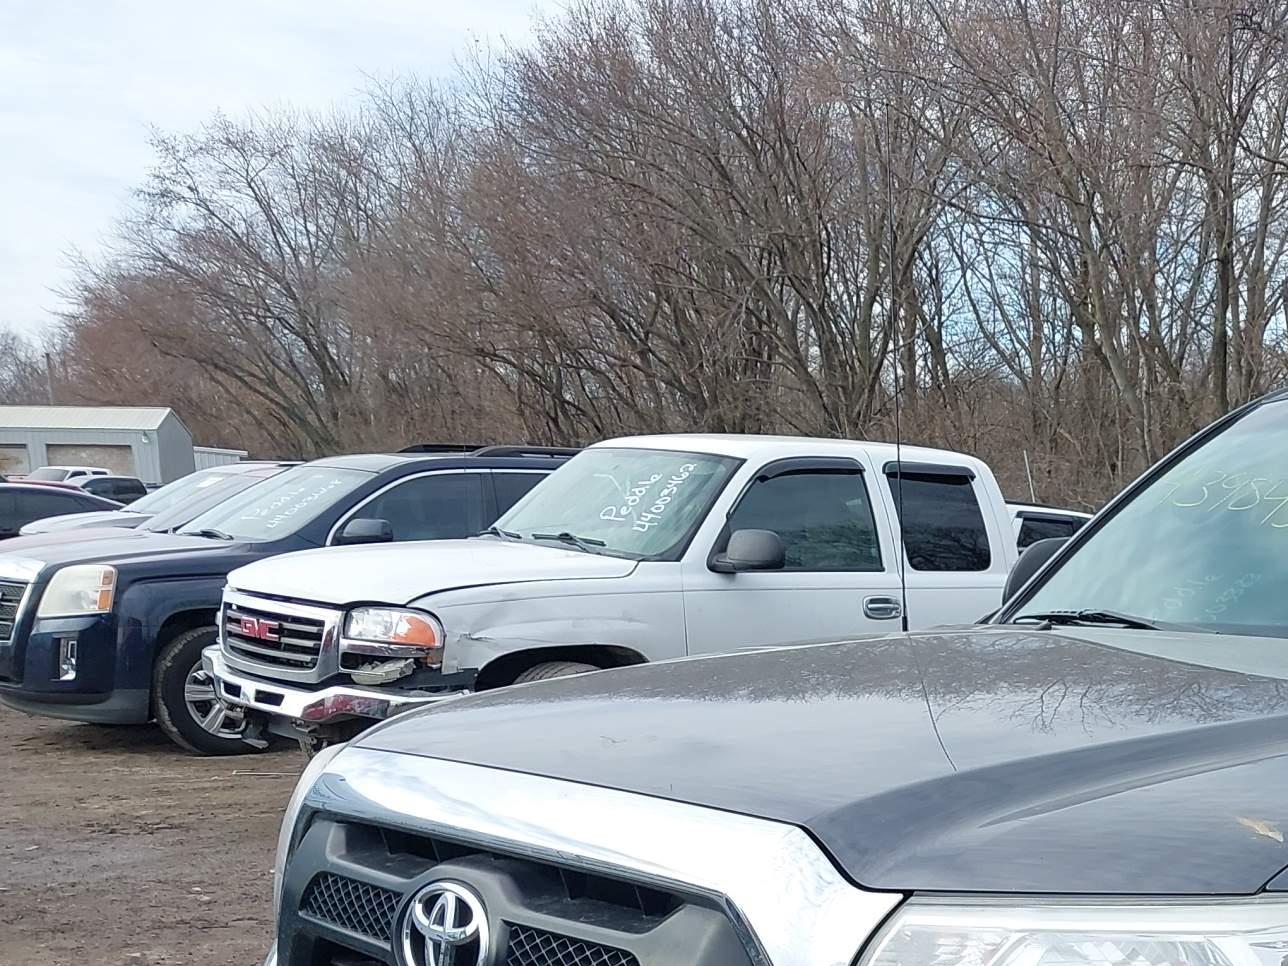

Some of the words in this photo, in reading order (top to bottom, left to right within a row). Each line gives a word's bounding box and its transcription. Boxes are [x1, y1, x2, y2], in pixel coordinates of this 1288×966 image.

[600, 472, 663, 522] Peddle
[632, 463, 697, 532] 44003462
[241, 616, 280, 641] GMC
